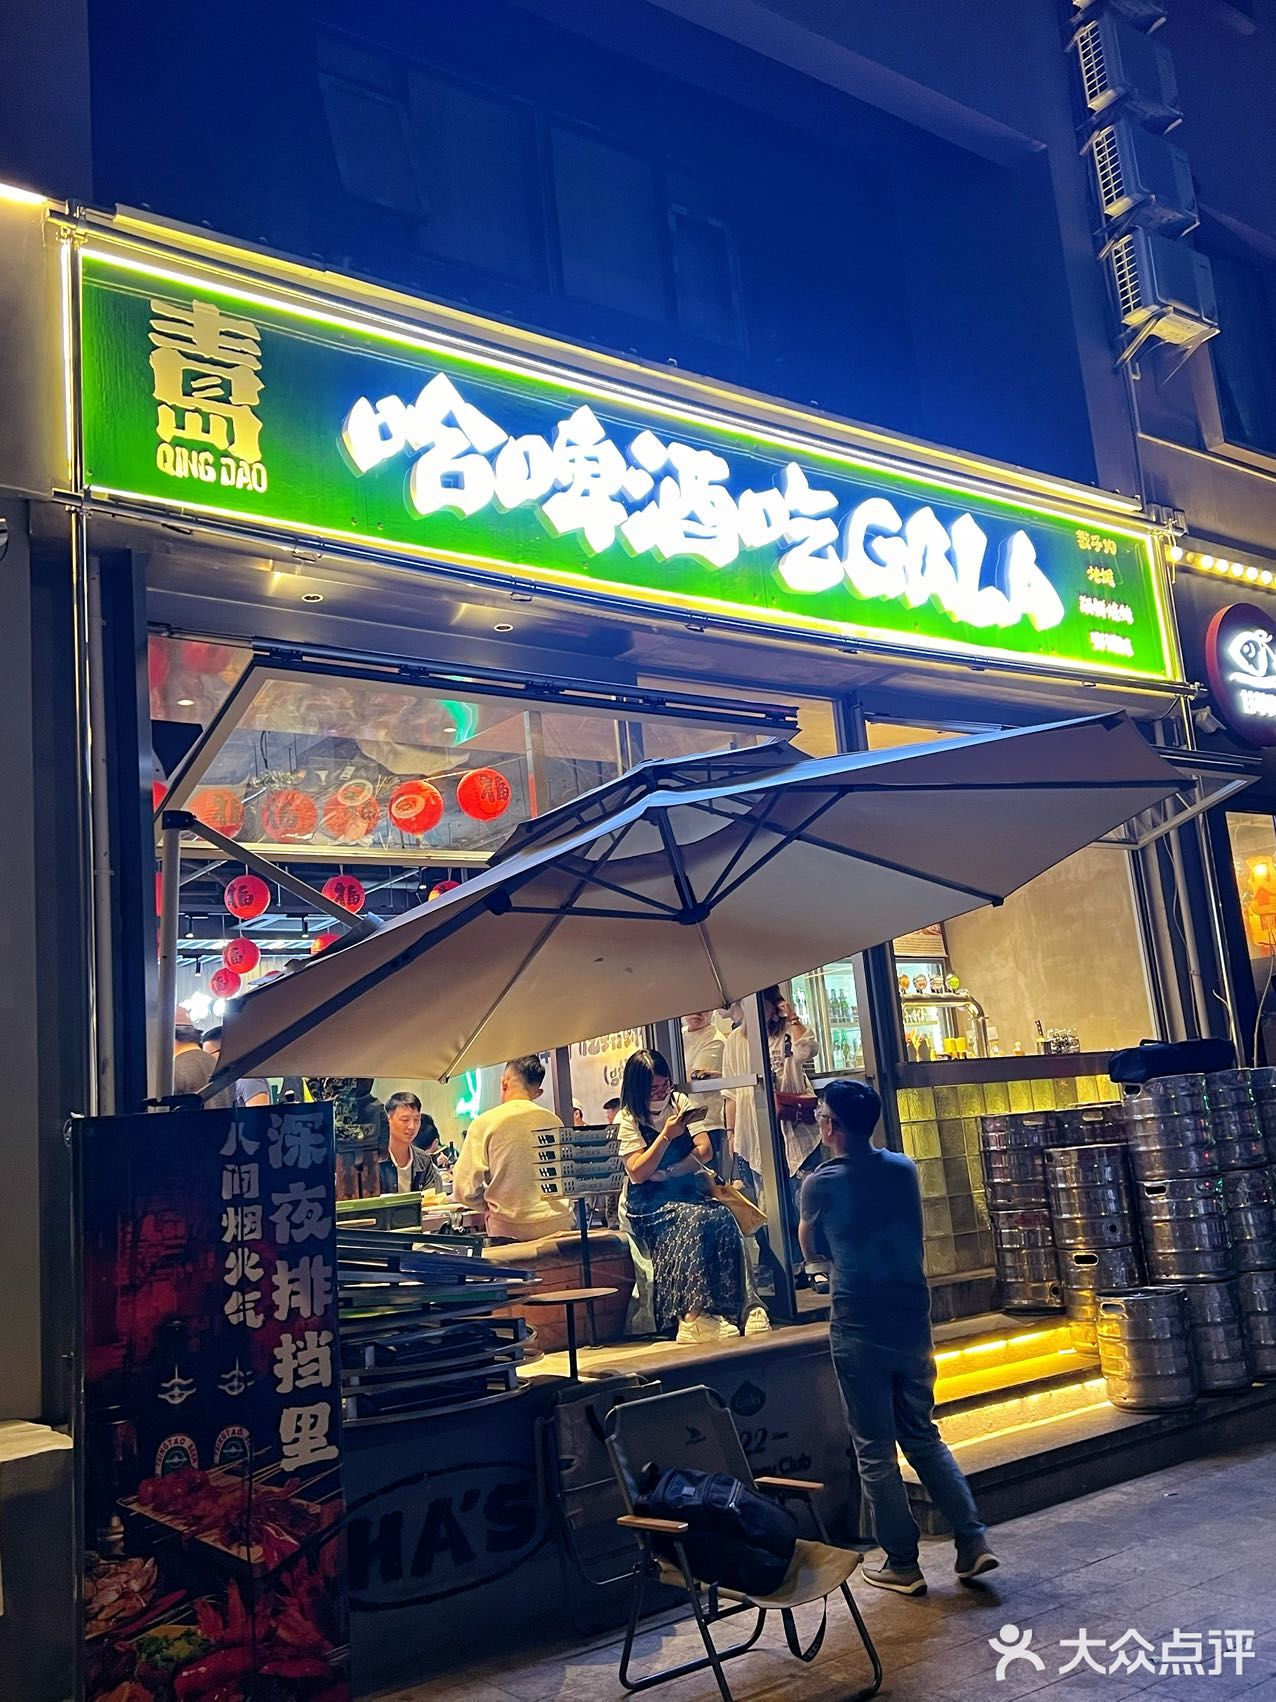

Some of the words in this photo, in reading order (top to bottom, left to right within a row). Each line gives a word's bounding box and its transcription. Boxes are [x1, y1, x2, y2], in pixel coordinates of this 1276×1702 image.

[156, 441, 216, 482] QING
[220, 455, 268, 494] DAO
[220, 1121, 265, 1329] 人间烟火气
